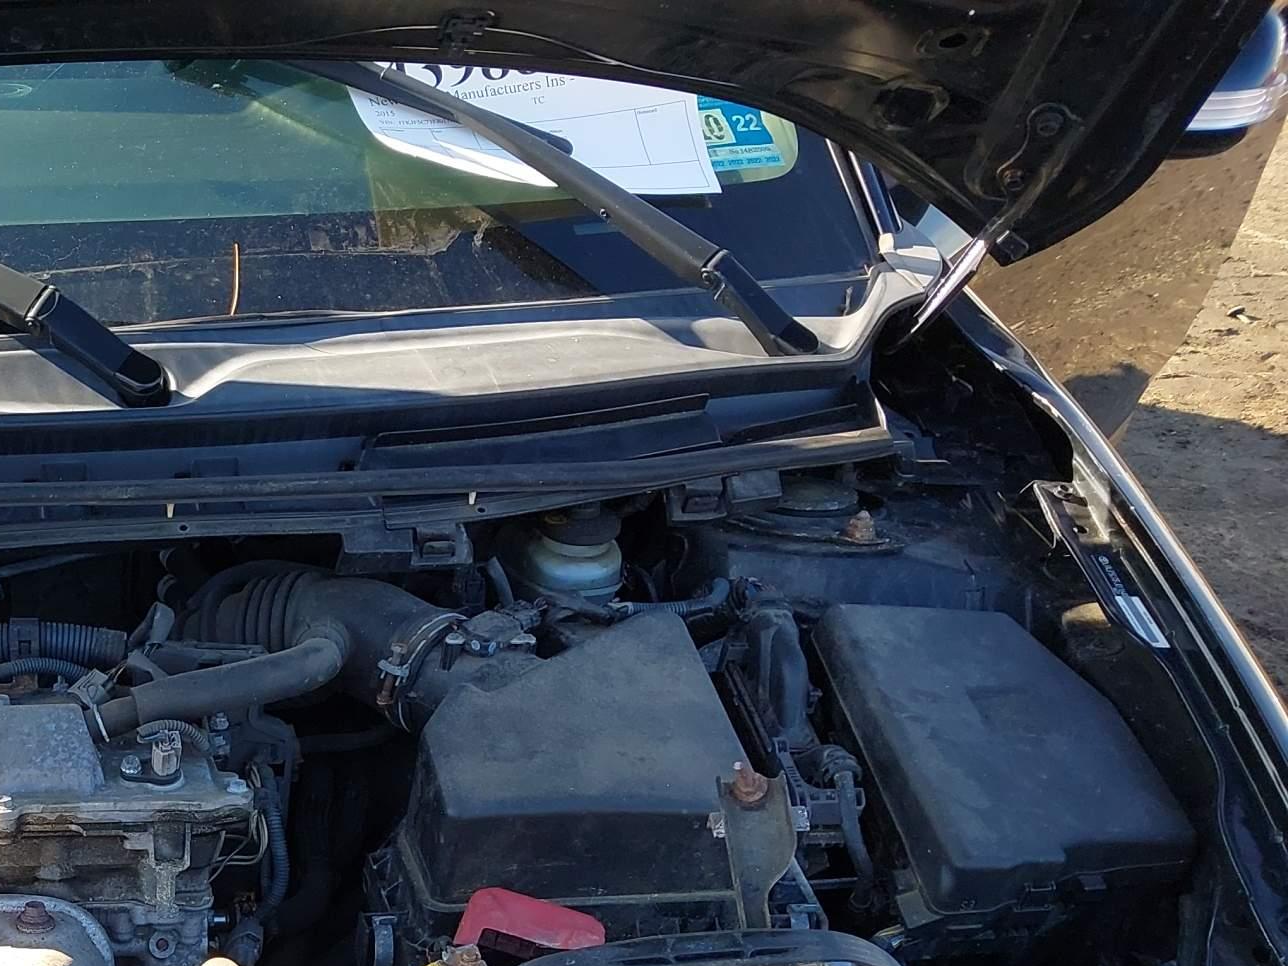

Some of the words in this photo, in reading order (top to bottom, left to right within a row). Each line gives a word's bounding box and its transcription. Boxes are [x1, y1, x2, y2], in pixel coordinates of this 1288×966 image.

[545, 75, 566, 88] Ins
[532, 95, 546, 105] TC
[731, 112, 763, 132] 22
